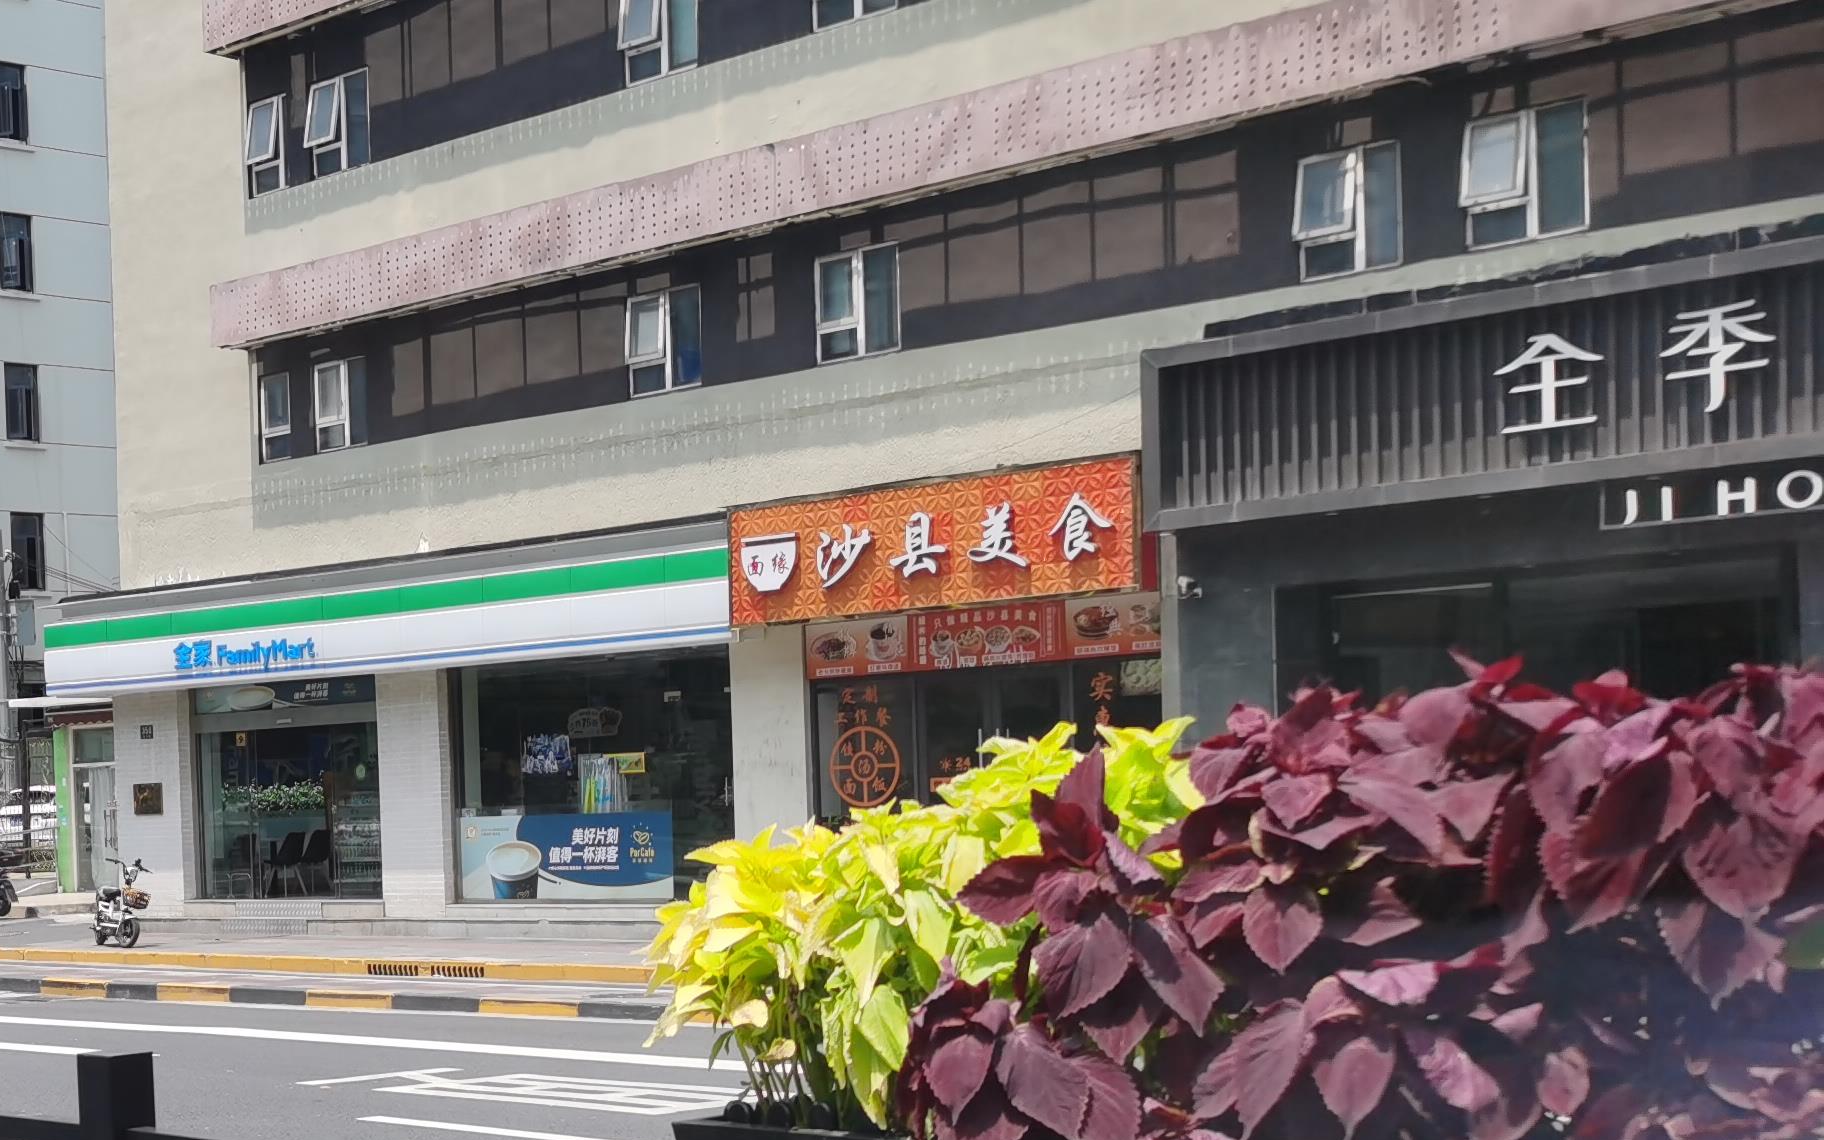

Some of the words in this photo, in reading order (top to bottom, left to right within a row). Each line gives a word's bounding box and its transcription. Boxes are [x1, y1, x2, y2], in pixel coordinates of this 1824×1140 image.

[1493, 299, 1776, 434] 全季
[1623, 486, 1673, 525] JI
[1717, 469, 1824, 515] HO
[816, 491, 1114, 588] 沙县美食
[747, 553, 789, 576] 面缘
[173, 639, 212, 669] 全家
[216, 637, 316, 671] FamilyMart
[572, 827, 619, 845] 美好片刻
[549, 846, 618, 864] 值得一杯湃客
